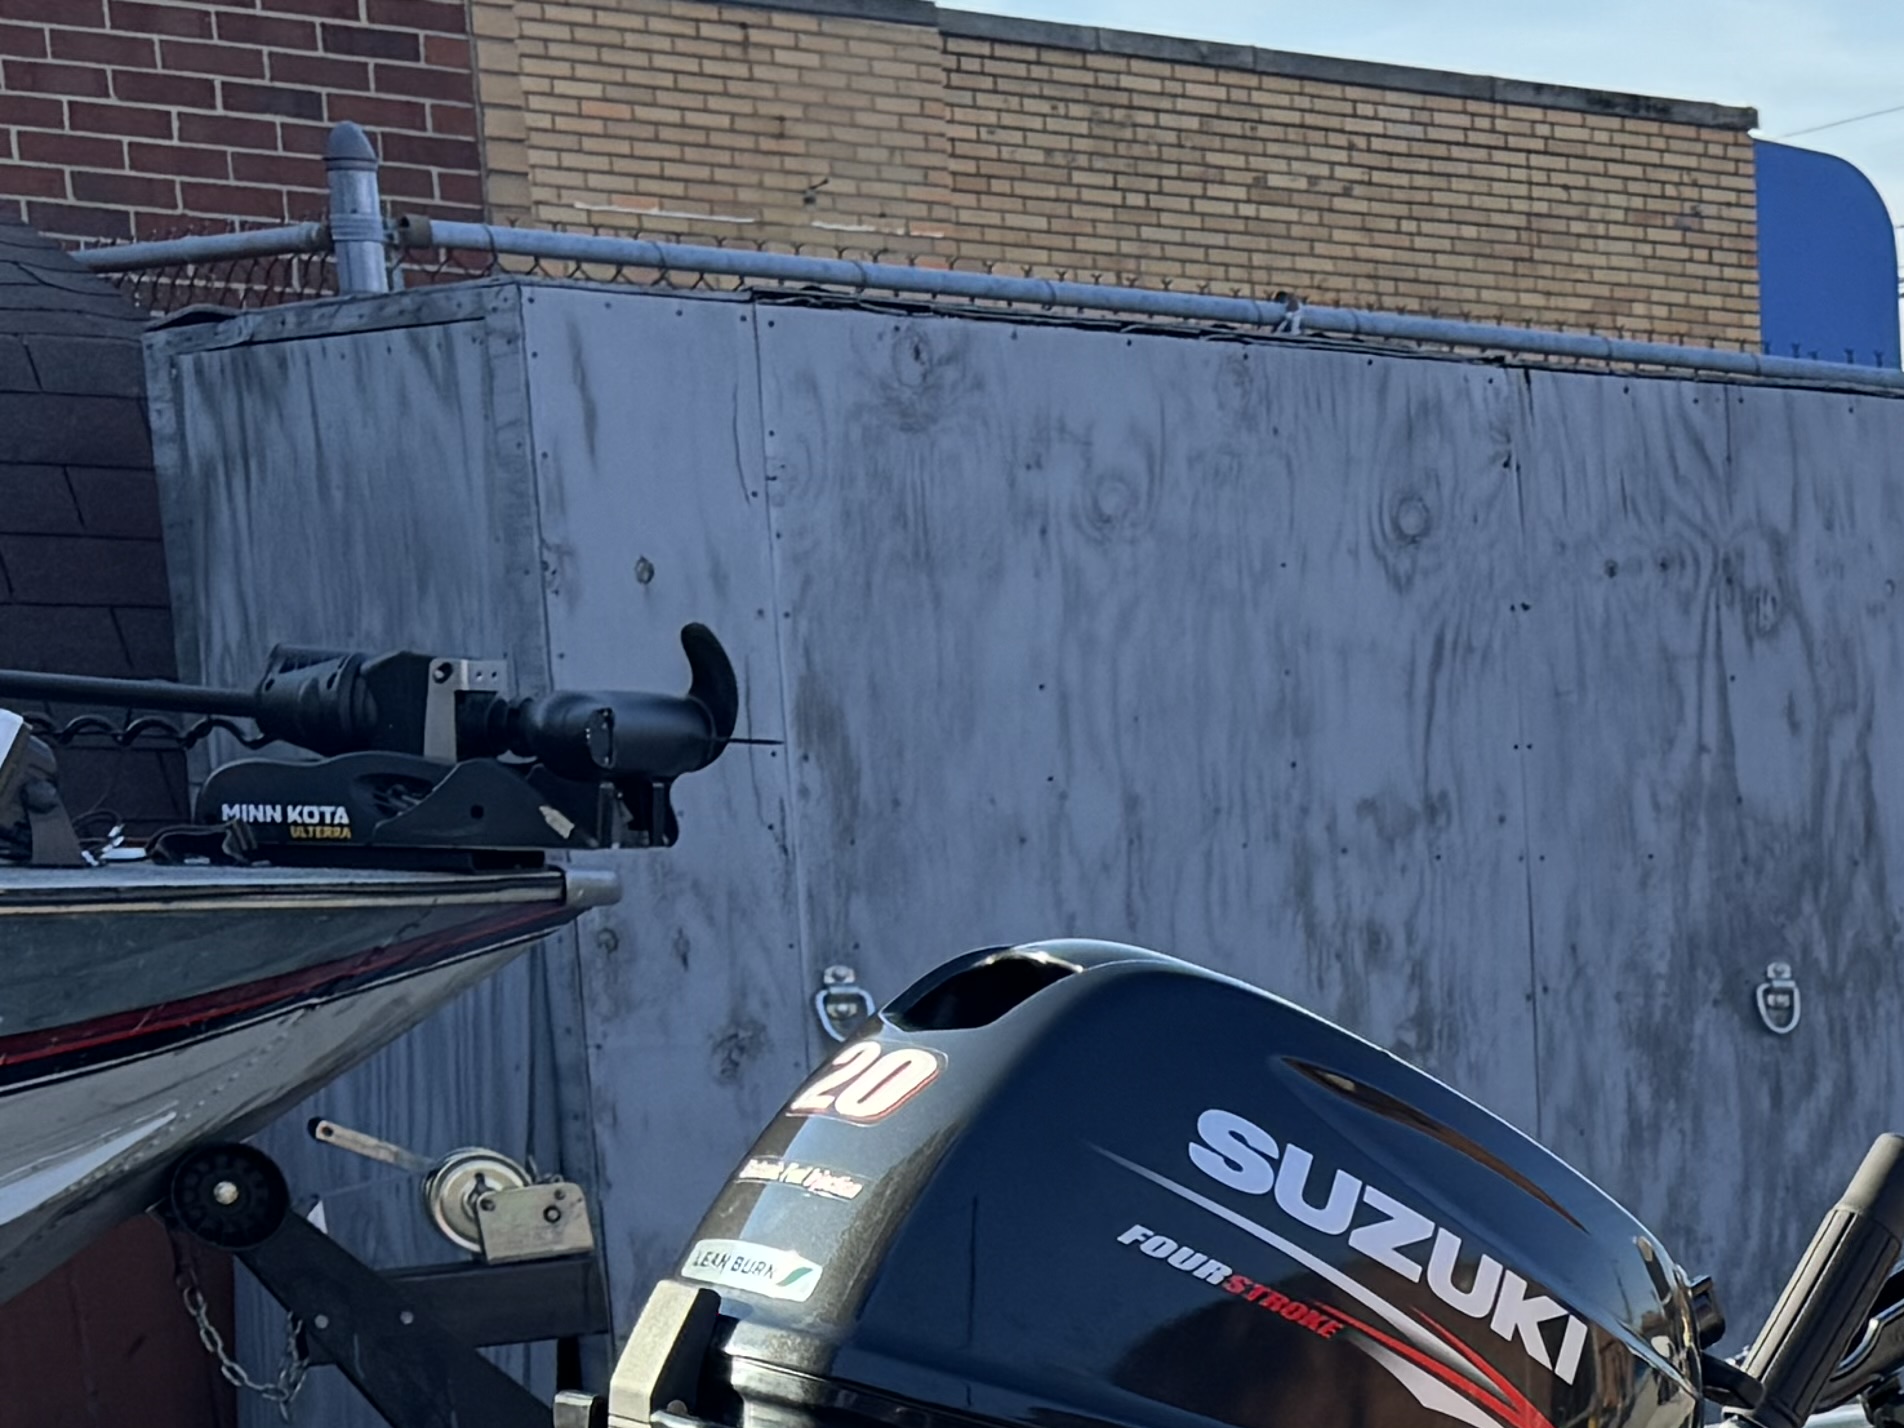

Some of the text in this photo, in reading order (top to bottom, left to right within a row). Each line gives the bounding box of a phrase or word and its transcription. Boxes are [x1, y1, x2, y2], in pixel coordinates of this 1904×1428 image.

[221, 803, 350, 825] MINN KOTA
[289, 825, 352, 839] ULTERRA
[788, 1040, 940, 1121] 20
[1188, 1107, 1588, 1386] SUZUKI
[692, 1250, 777, 1280] LEAN BURN
